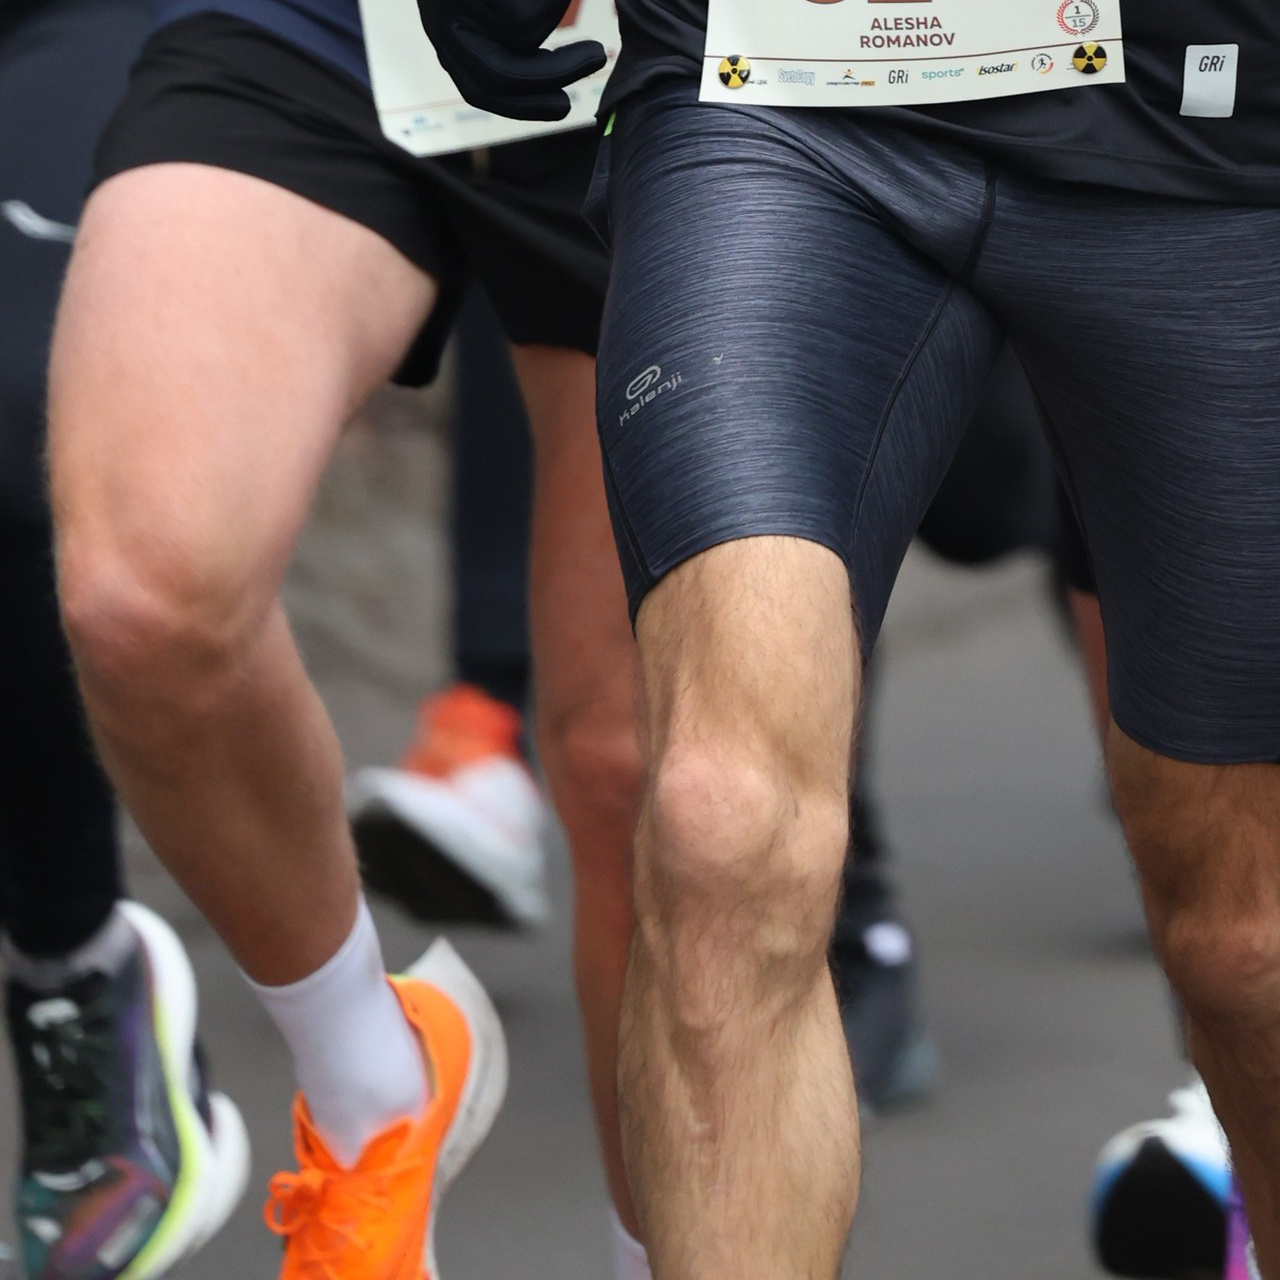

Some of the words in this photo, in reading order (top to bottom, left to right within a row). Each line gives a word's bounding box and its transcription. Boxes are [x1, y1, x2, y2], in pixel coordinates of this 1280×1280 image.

[1073, 5, 1082, 16] 1
[870, 15, 943, 32] ALESHA
[1071, 18, 1087, 29] 15
[860, 32, 956, 49] ROMANOV
[1198, 55, 1227, 73] GRi
[887, 69, 910, 85] GRi
